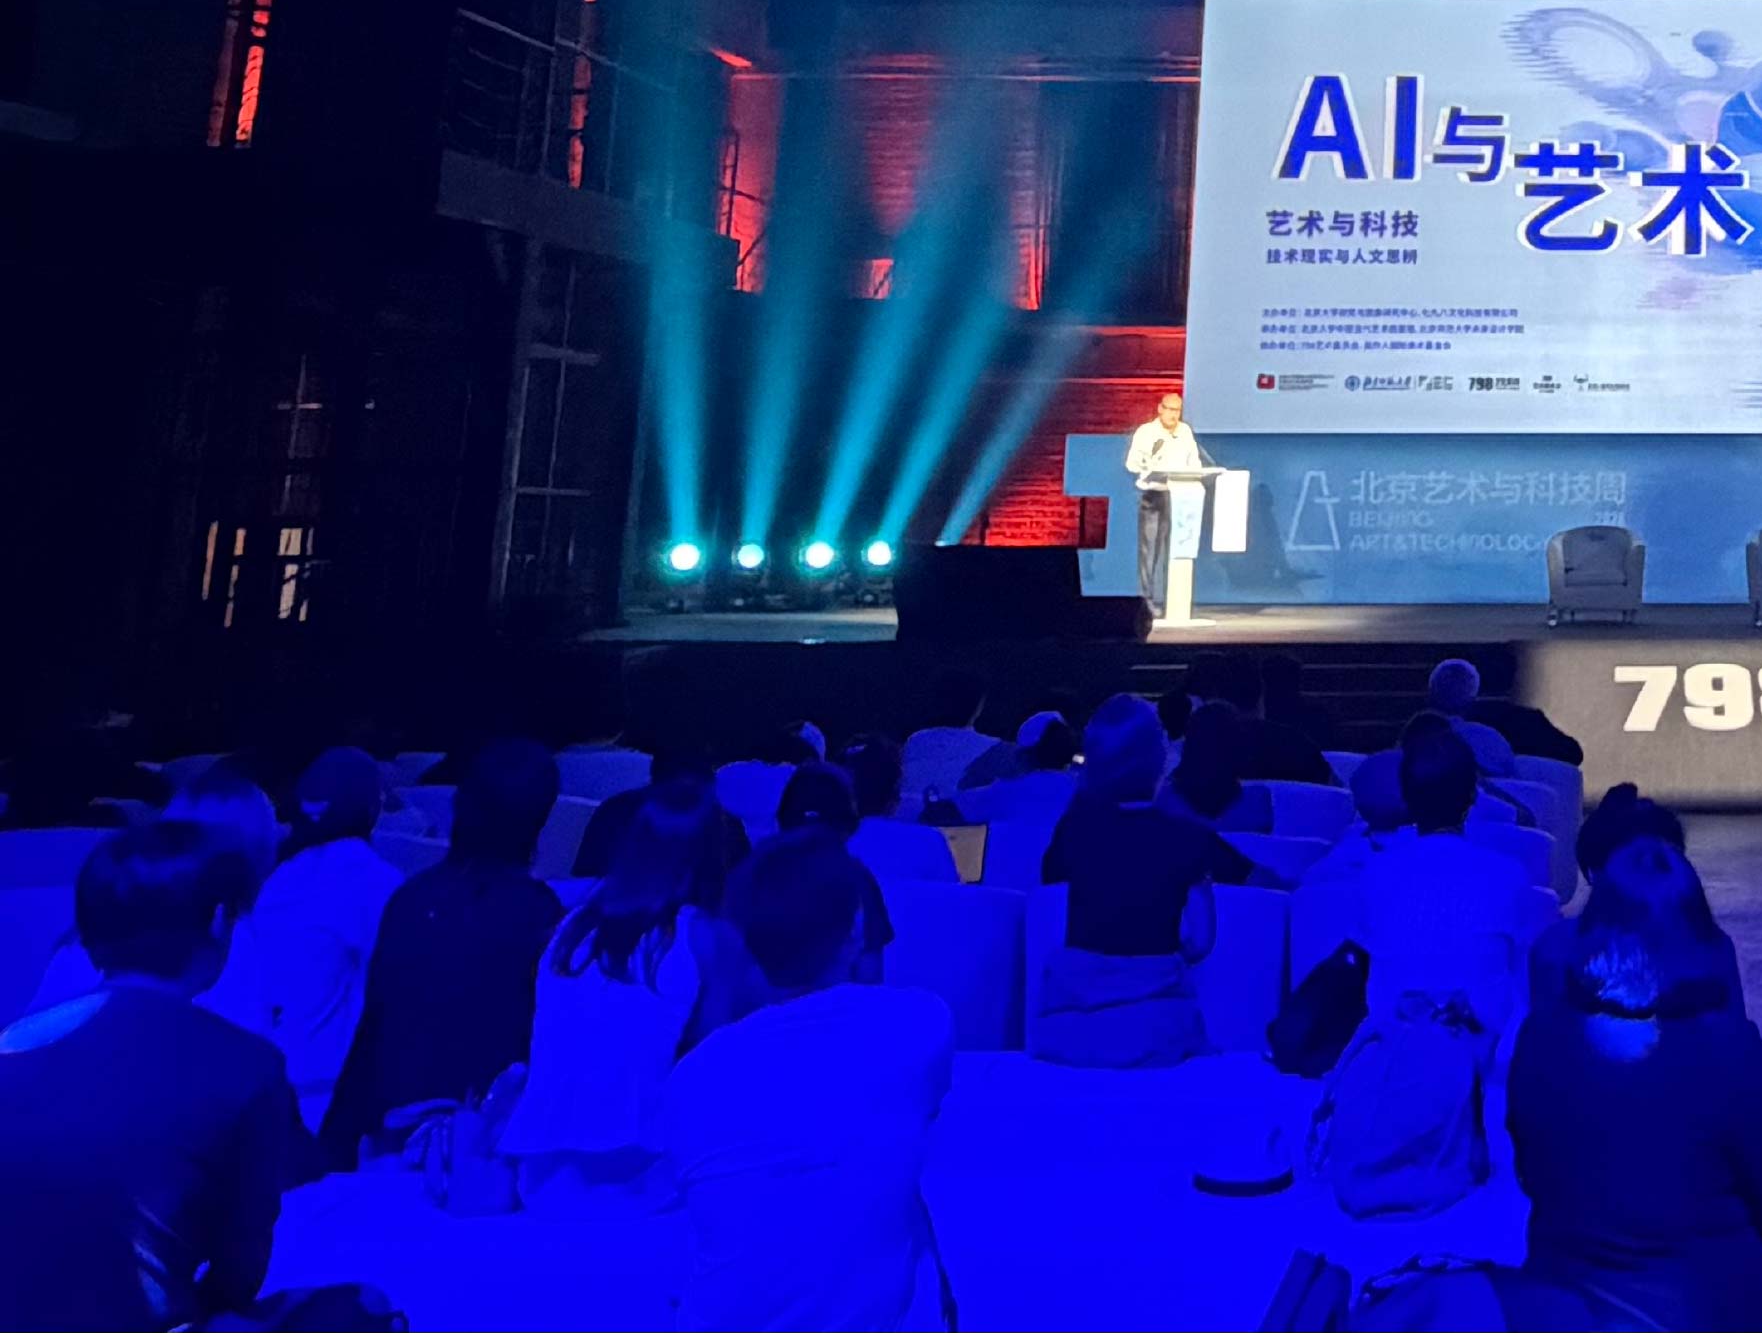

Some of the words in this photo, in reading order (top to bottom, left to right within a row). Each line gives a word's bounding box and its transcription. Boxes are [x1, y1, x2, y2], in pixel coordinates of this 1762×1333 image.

[1276, 72, 1753, 256] AI与艺术
[1265, 209, 1419, 238] 艺术与科技
[1350, 470, 1626, 506] 北京艺术与科技周
[1350, 533, 1546, 552] ART&TECHNOLOG
